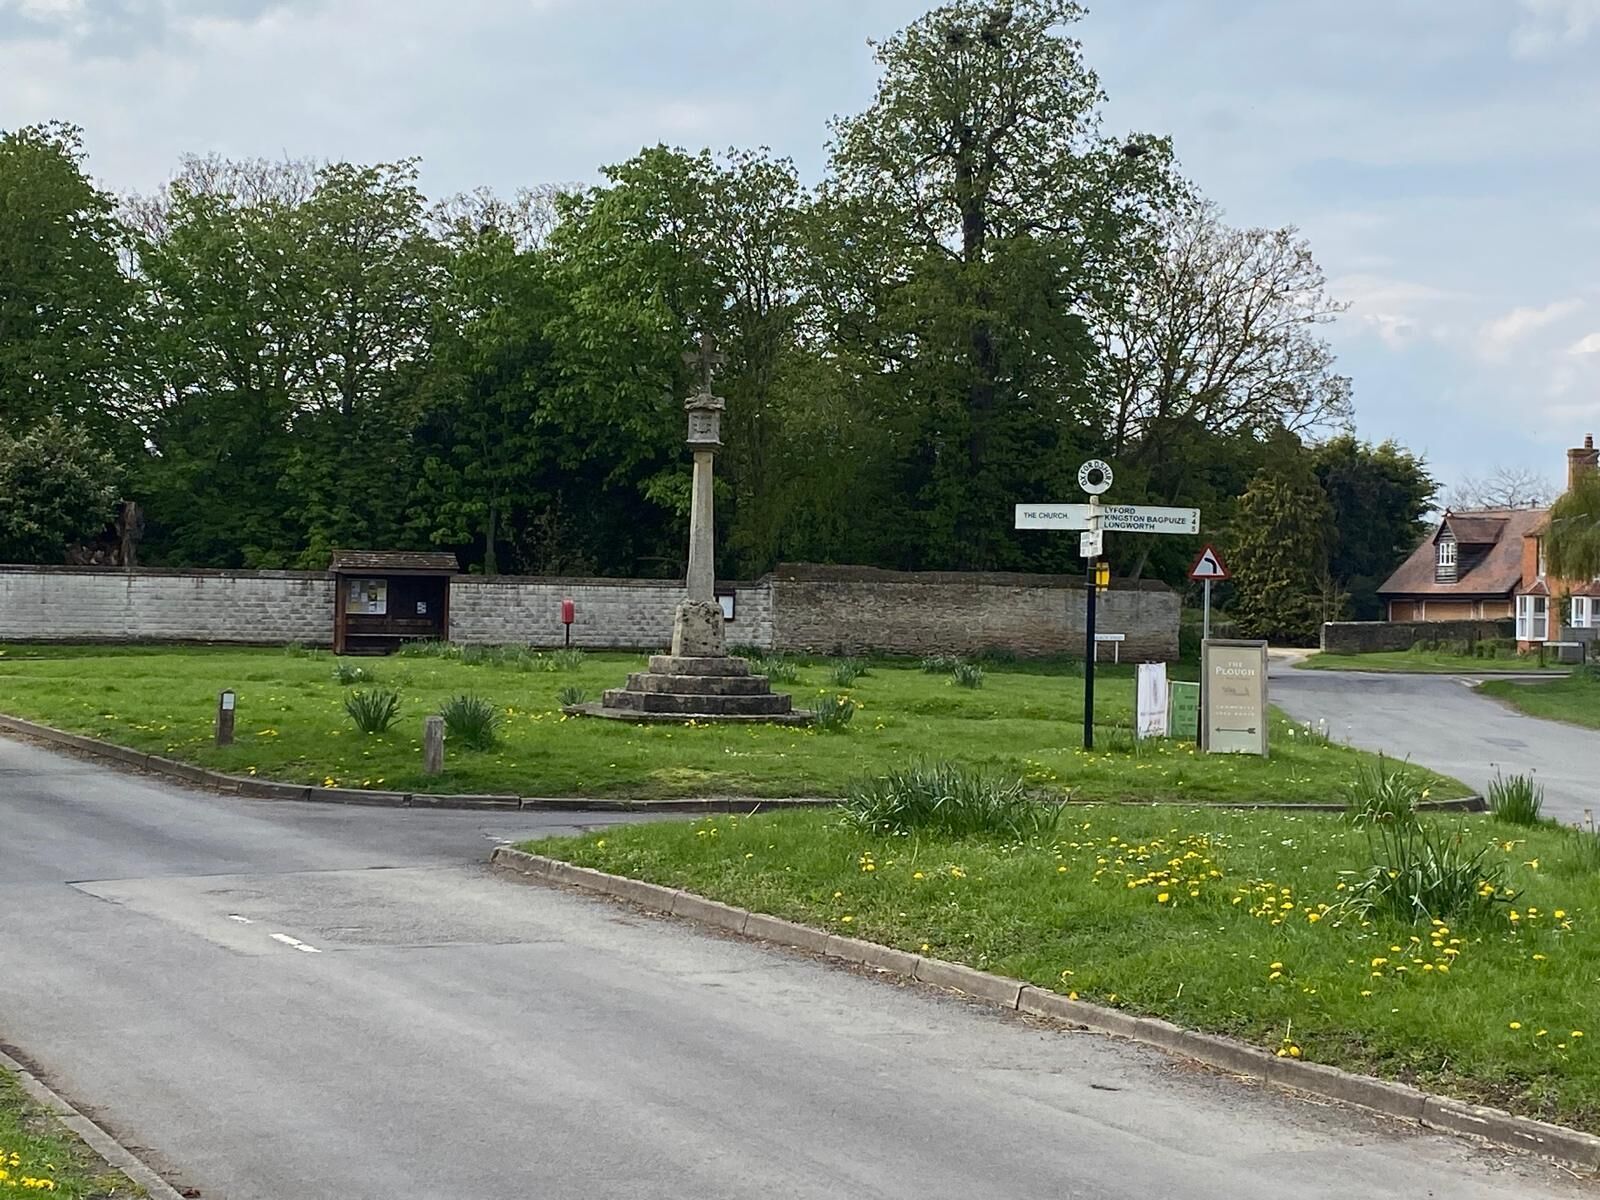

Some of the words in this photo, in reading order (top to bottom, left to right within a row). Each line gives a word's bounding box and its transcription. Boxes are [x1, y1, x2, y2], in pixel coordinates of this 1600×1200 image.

[1079, 460, 1112, 487] OXFORDSHIRE
[1023, 511, 1037, 519] THE
[1104, 506, 1136, 515] LYFORD
[1104, 514, 1145, 523] KINGSTON
[1146, 516, 1186, 525] BAGPUIZE
[1104, 521, 1155, 530] LONGWORTH
